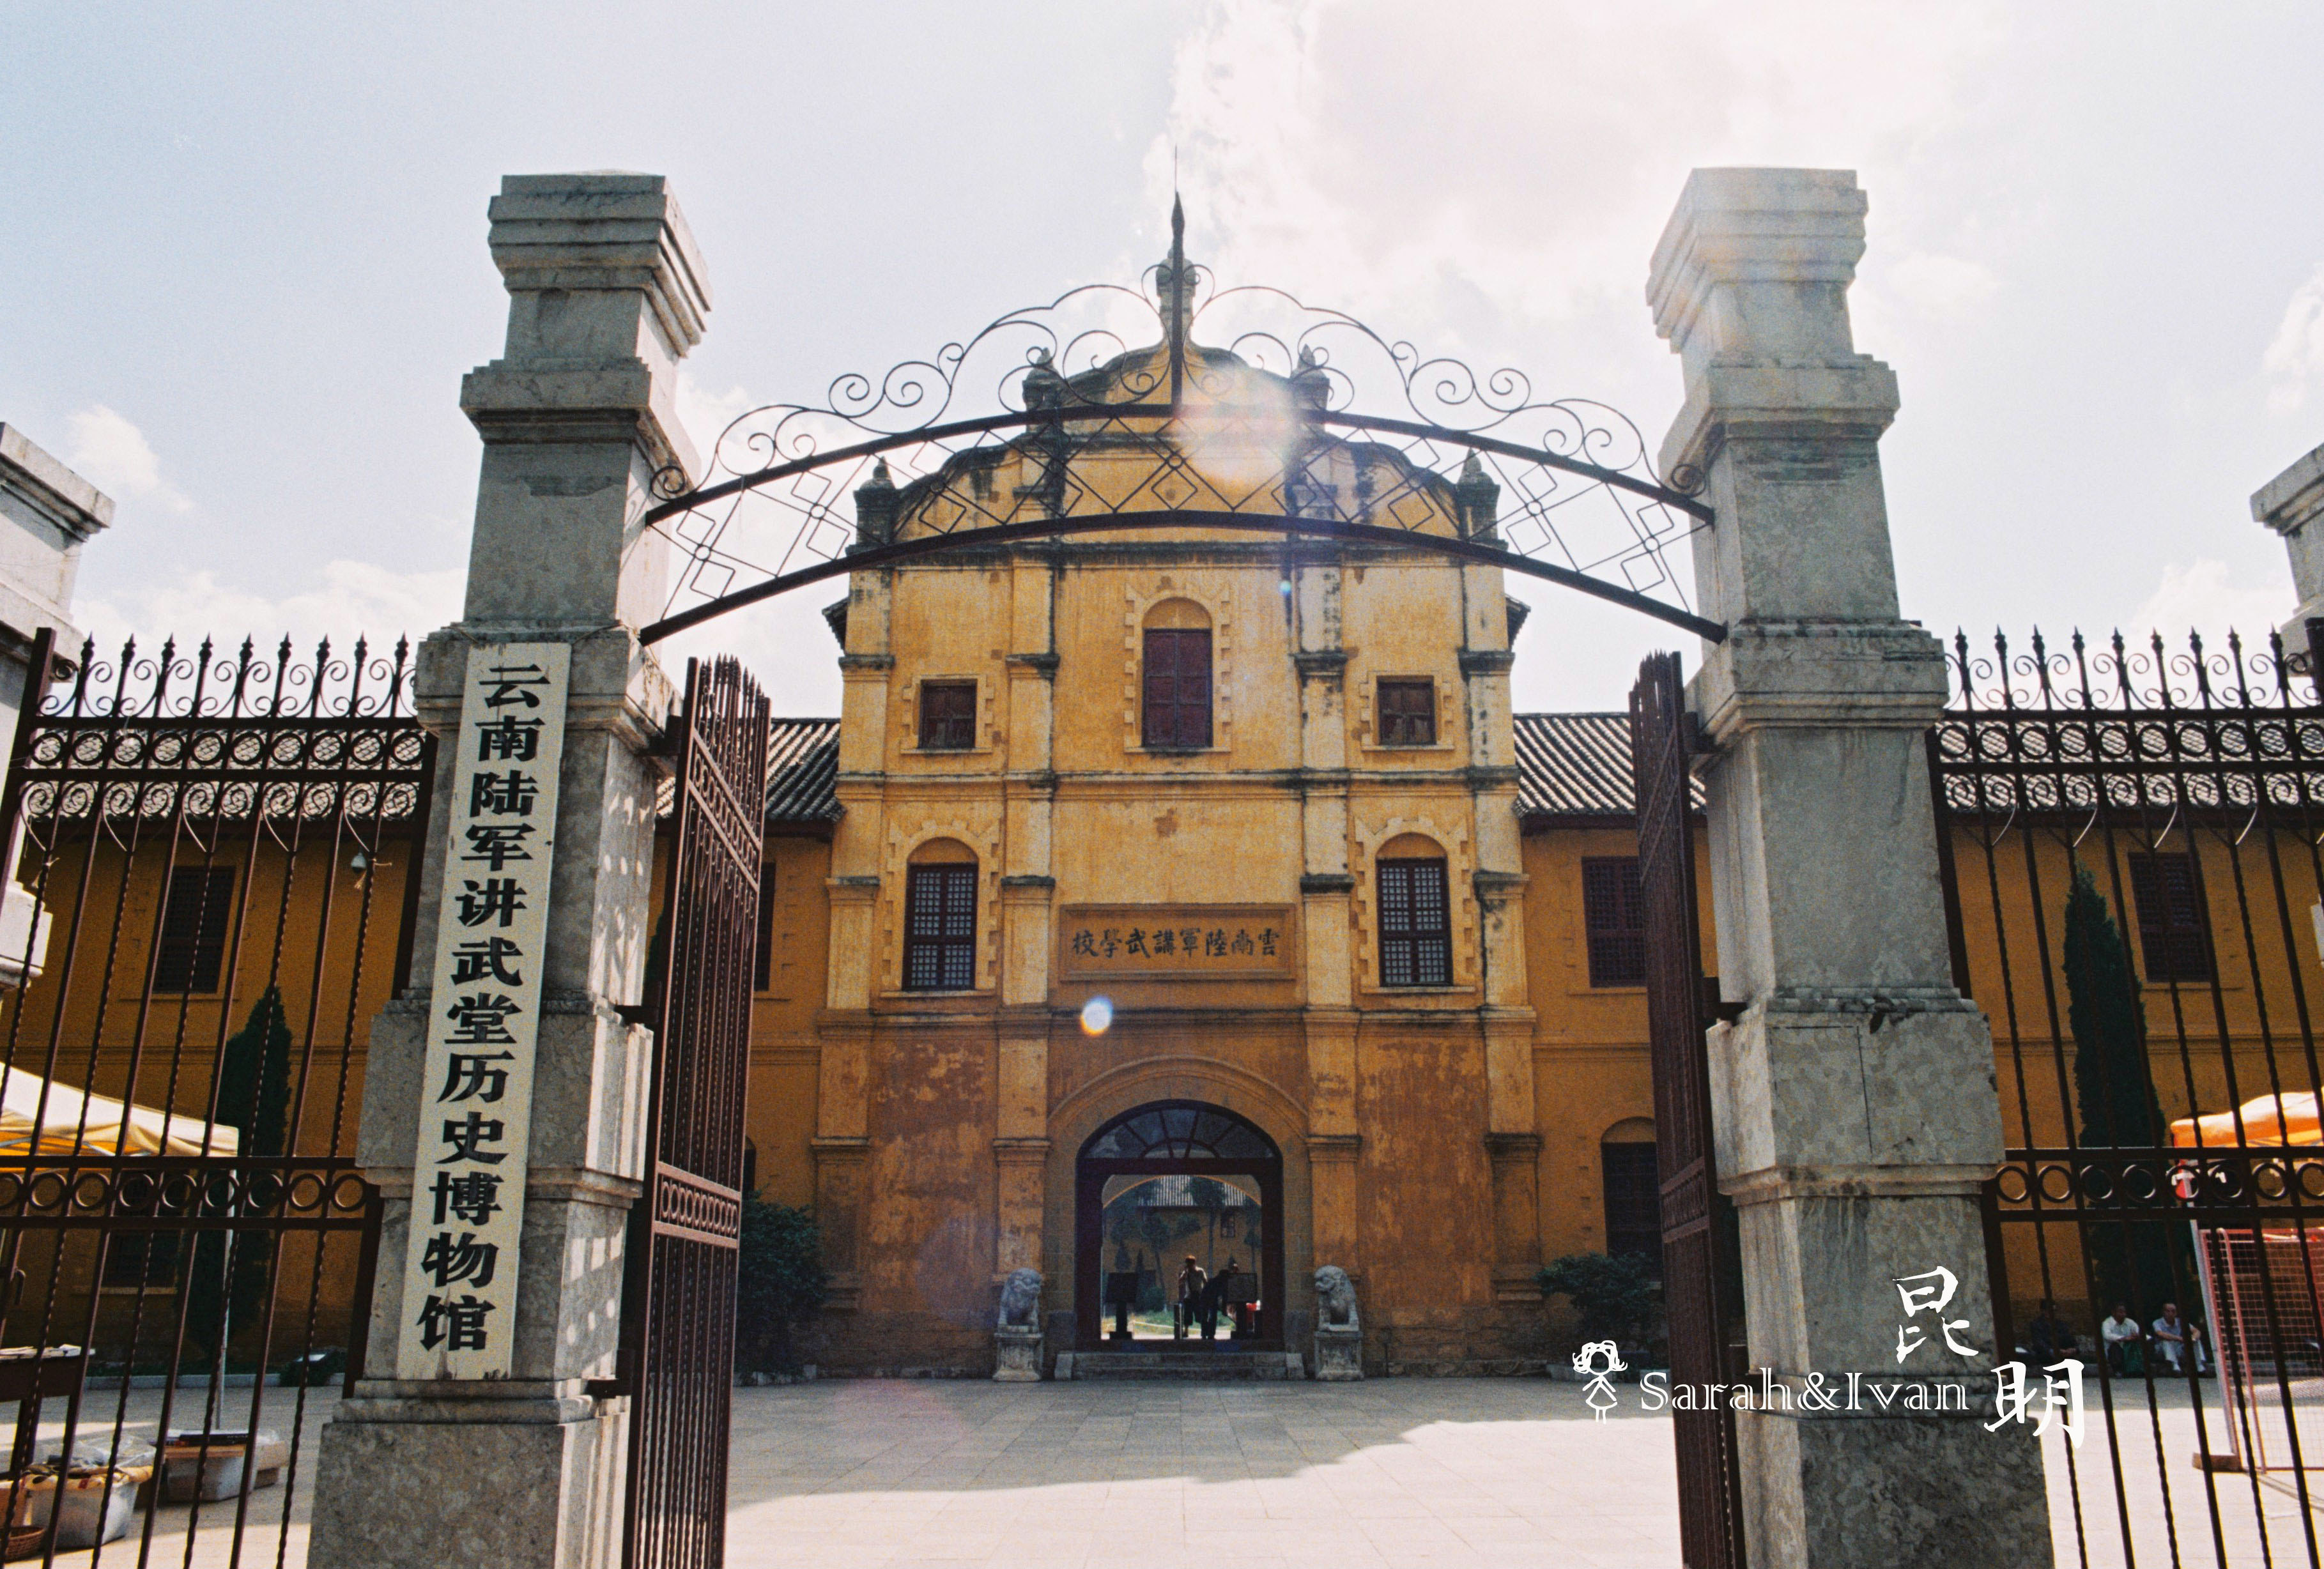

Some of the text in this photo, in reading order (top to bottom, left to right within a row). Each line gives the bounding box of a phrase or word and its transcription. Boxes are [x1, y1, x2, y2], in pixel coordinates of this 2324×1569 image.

[417, 664, 550, 1352] 云南陆军讲武堂历史博物馆
